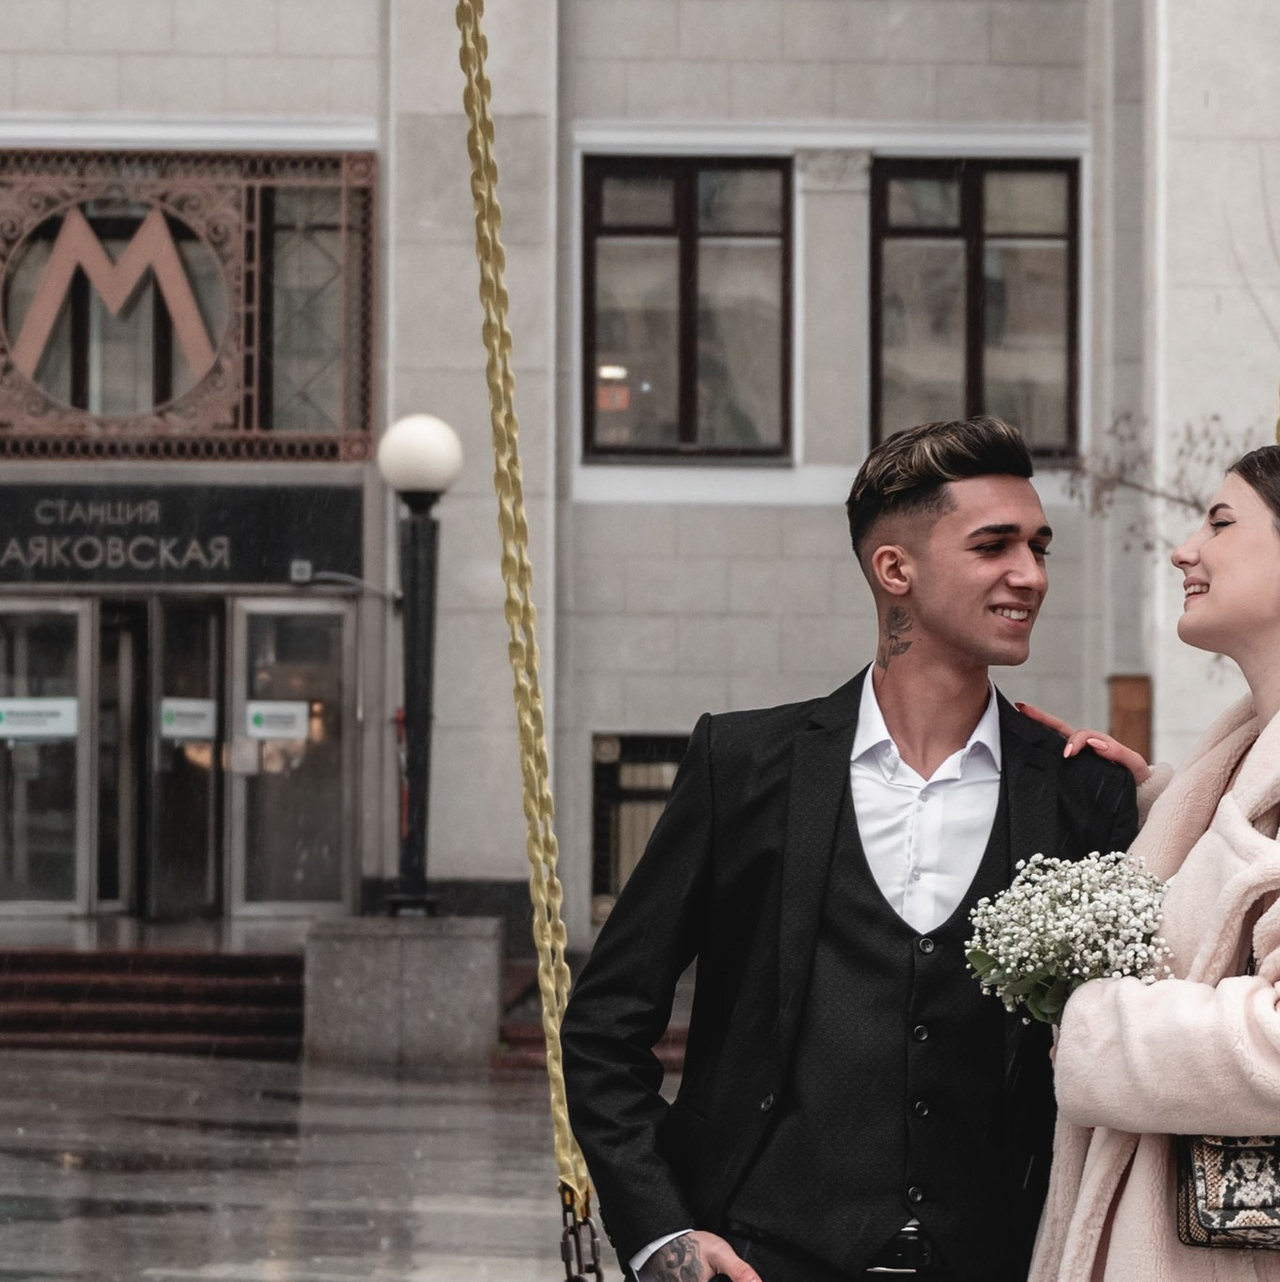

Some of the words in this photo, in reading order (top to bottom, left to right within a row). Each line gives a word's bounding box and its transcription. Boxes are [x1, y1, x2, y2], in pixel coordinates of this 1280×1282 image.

[10, 205, 216, 381] М
[35, 500, 160, 526] СТАНЦИЯ
[0, 535, 229, 570] АЯКОВСКАЯ
